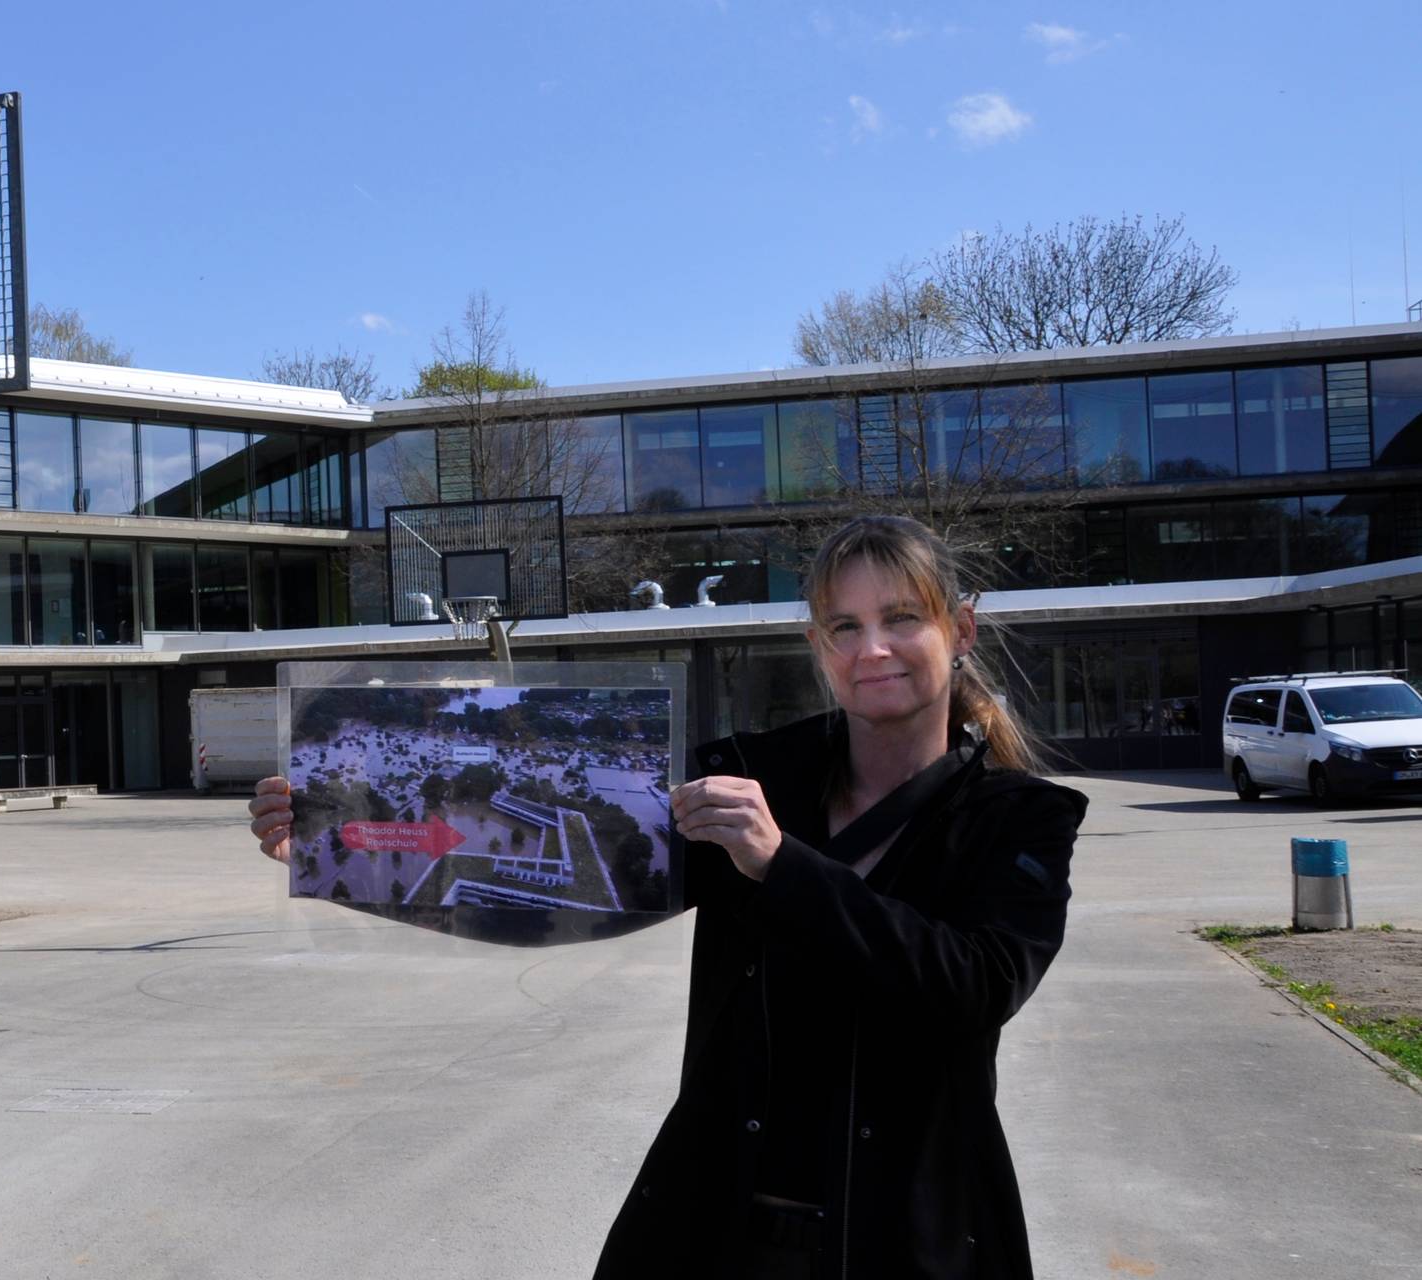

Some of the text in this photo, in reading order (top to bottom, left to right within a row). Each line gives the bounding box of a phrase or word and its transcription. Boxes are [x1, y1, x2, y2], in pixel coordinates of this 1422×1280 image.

[358, 825, 428, 836] Theodor Heuss
[366, 838, 418, 848] Realschule
